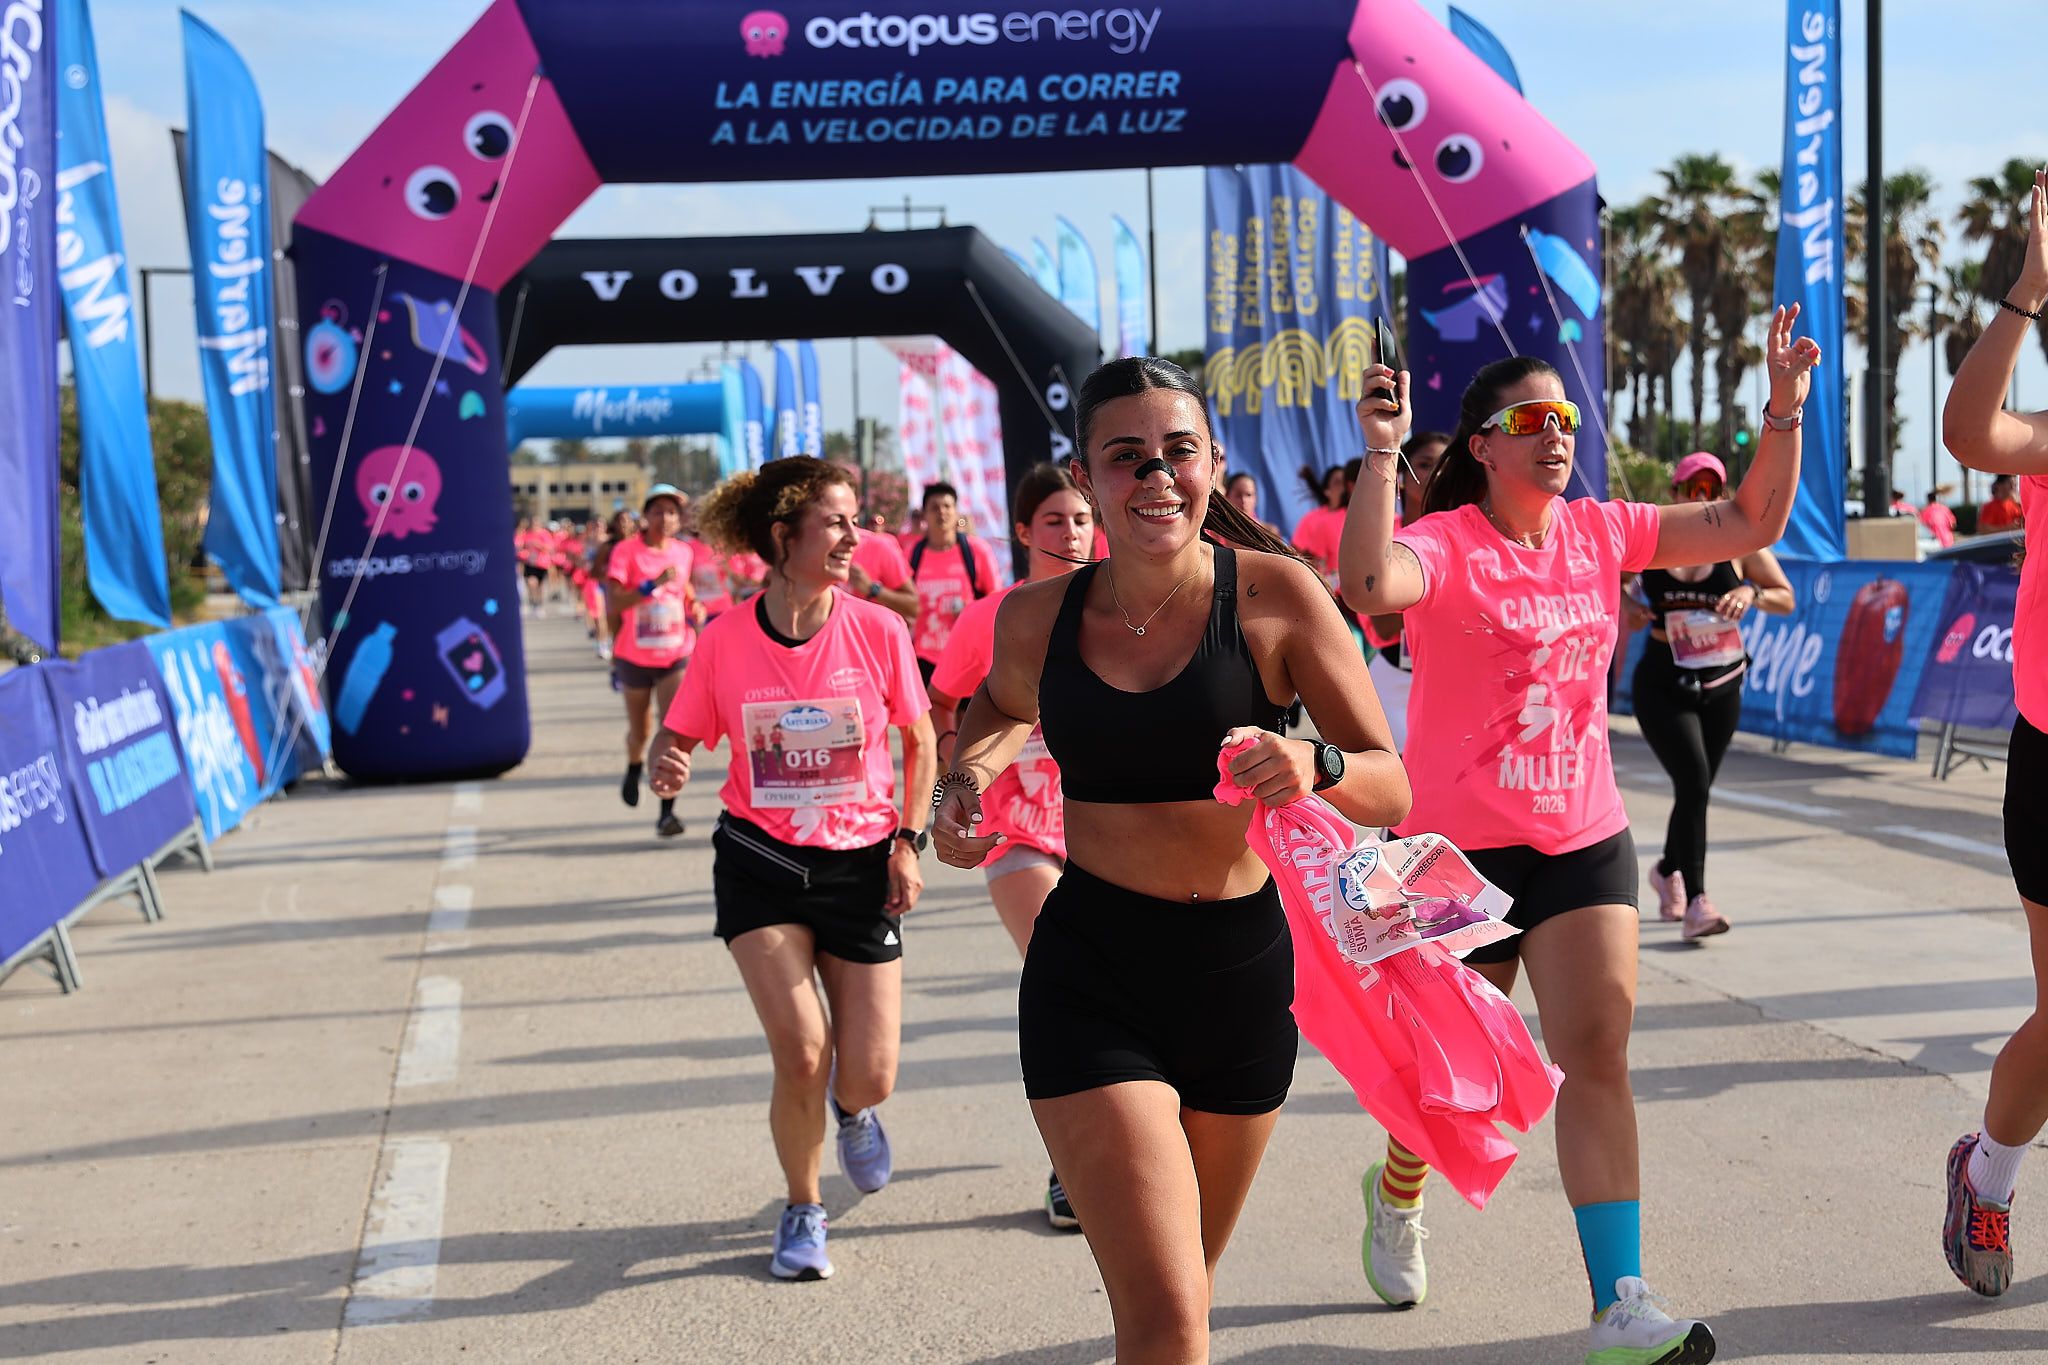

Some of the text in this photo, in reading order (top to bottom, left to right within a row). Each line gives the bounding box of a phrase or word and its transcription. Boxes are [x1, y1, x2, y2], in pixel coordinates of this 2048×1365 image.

[715, 70, 1182, 109] LA ENERGÍA PARA CORRER
[710, 107, 1188, 146] A LA VELOCIDAD DE LA LUZ
[580, 263, 910, 302] VOLVO
[1500, 590, 1610, 630] CARRERA
[1557, 637, 1597, 683] DE
[785, 749, 831, 768] 016
[1497, 751, 1586, 792] MUJER
[1008, 795, 1064, 835] MUJE
[1531, 795, 1567, 814] 2026
[1350, 915, 1368, 954] SUMA
